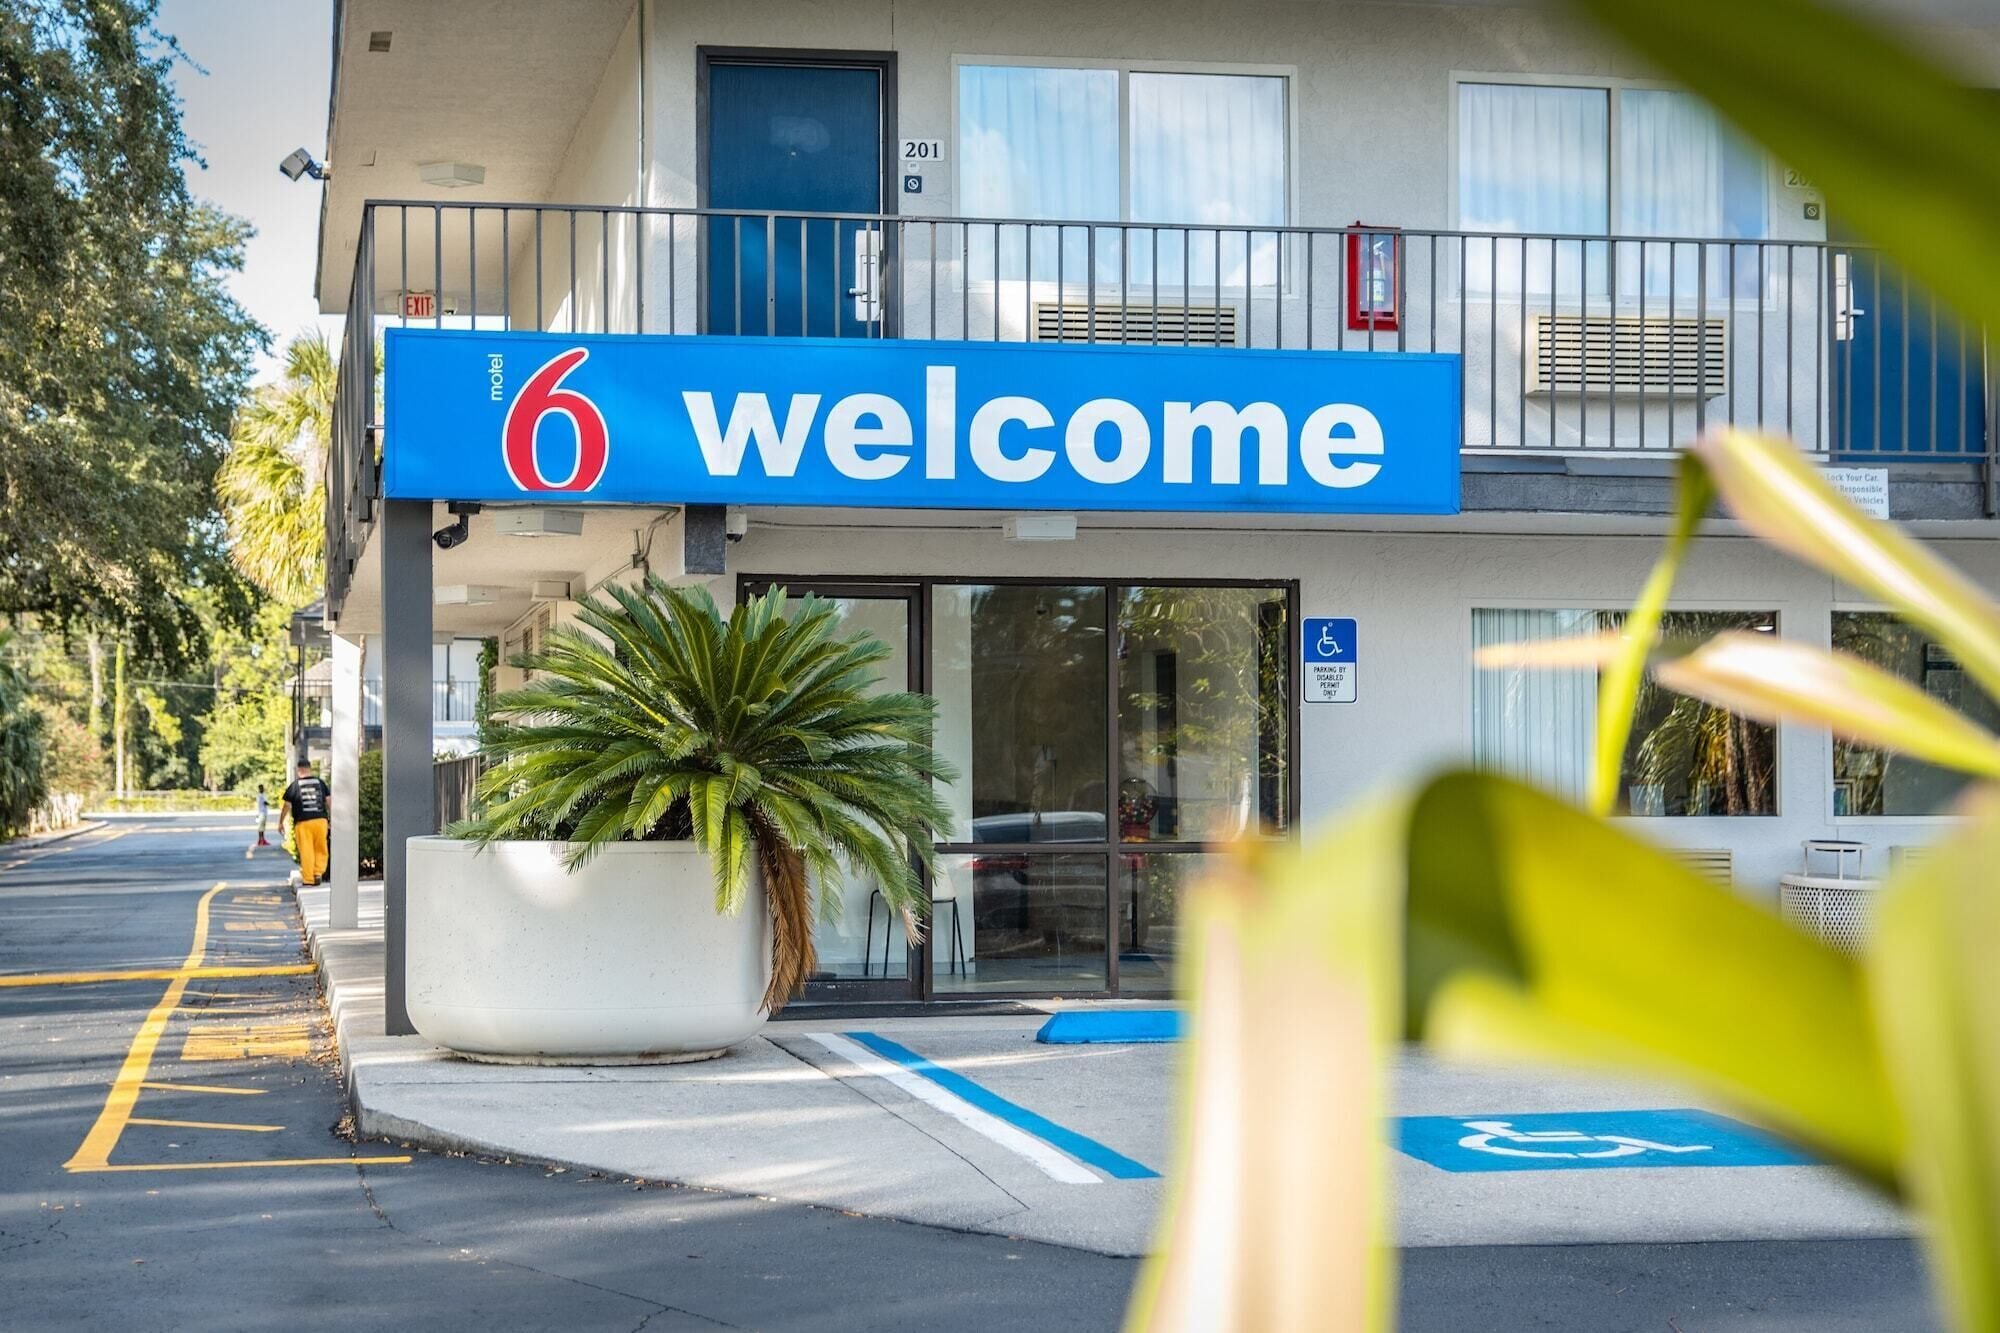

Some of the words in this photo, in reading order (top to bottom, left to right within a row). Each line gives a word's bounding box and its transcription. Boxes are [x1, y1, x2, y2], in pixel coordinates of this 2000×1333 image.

[905, 142, 938, 158] 201
[406, 296, 431, 316] EXIT
[488, 353, 504, 401] motel
[502, 346, 610, 493] 6
[682, 365, 1385, 489] welcome
[1845, 473, 1862, 482] Your
[1839, 484, 1883, 494] Responsible
[1854, 496, 1884, 505] Vehicles
